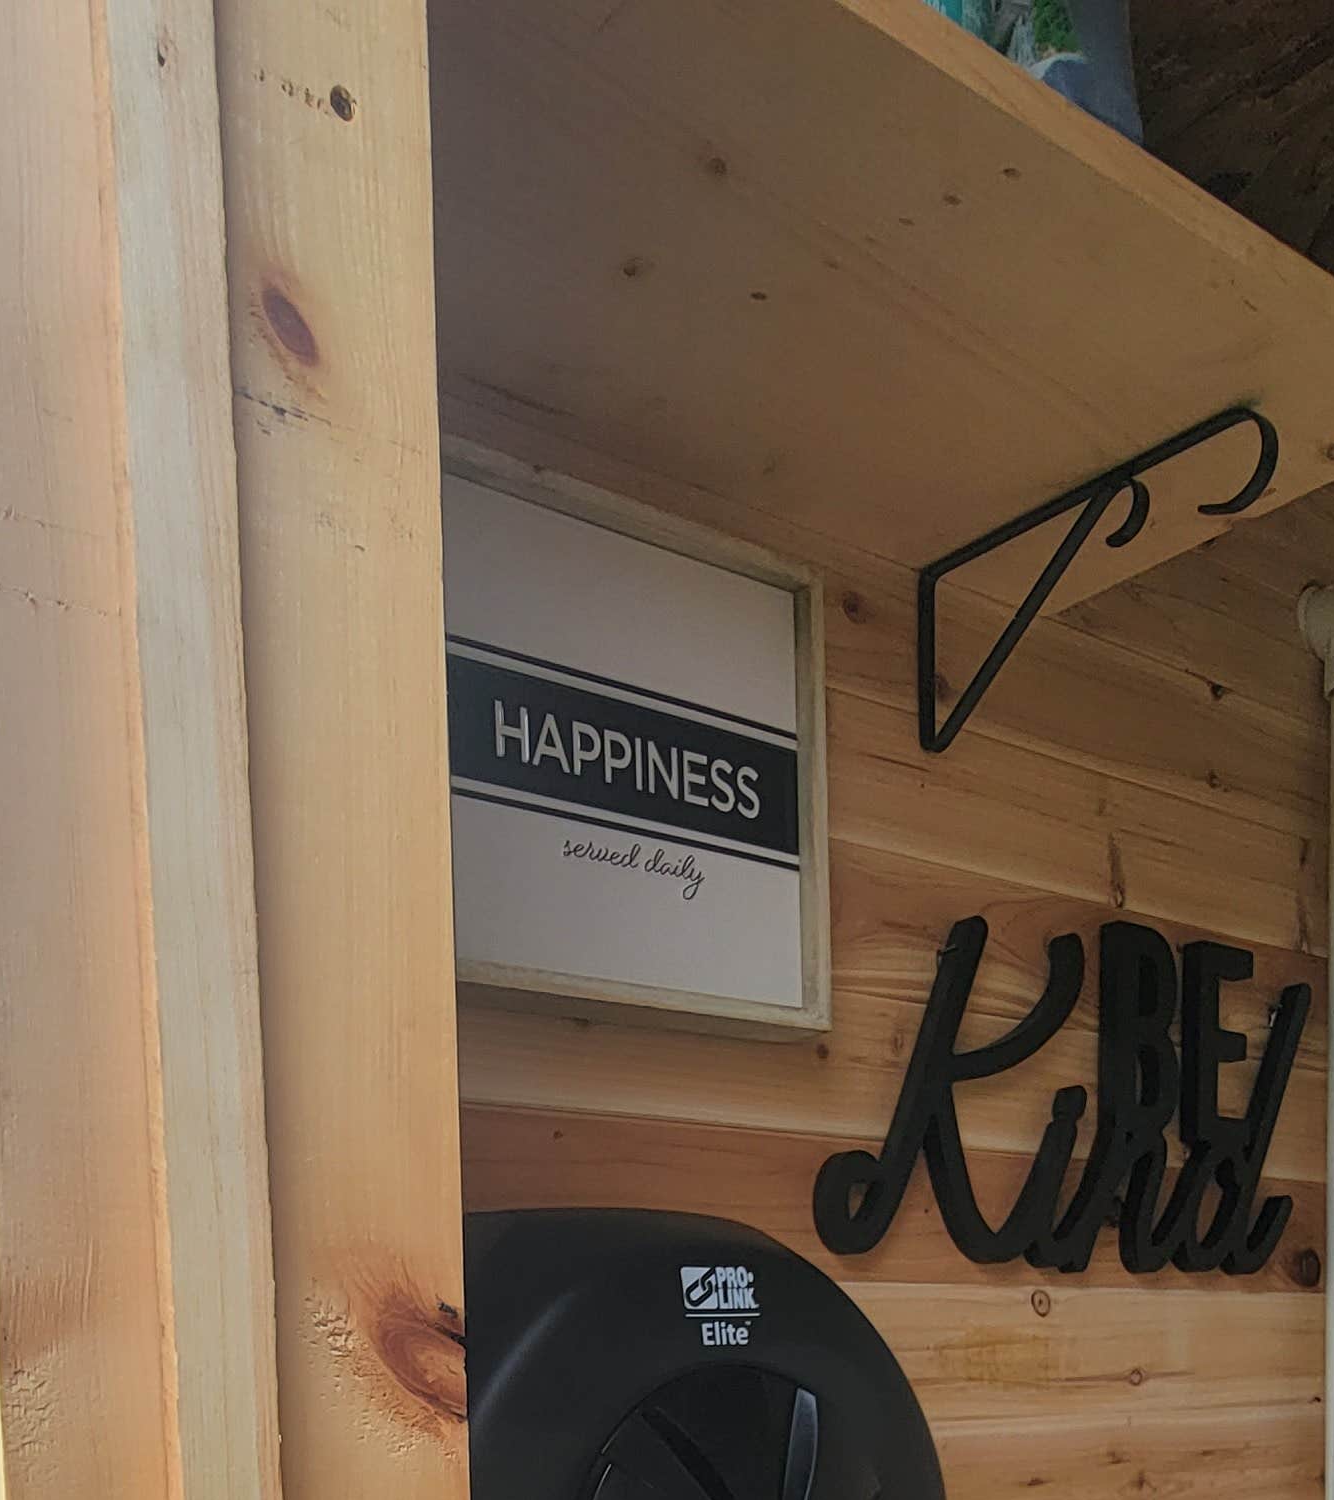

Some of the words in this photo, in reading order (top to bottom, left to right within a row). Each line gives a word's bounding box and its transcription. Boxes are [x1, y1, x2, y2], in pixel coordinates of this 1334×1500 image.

[493, 699, 761, 820] HAPPINESS
[563, 839, 640, 871] served
[642, 845, 706, 901] daily
[1099, 920, 1254, 1142] BE
[812, 915, 1312, 1275] Kind
[701, 1321, 749, 1346] Elite
[717, 1286, 757, 1309] LINK
